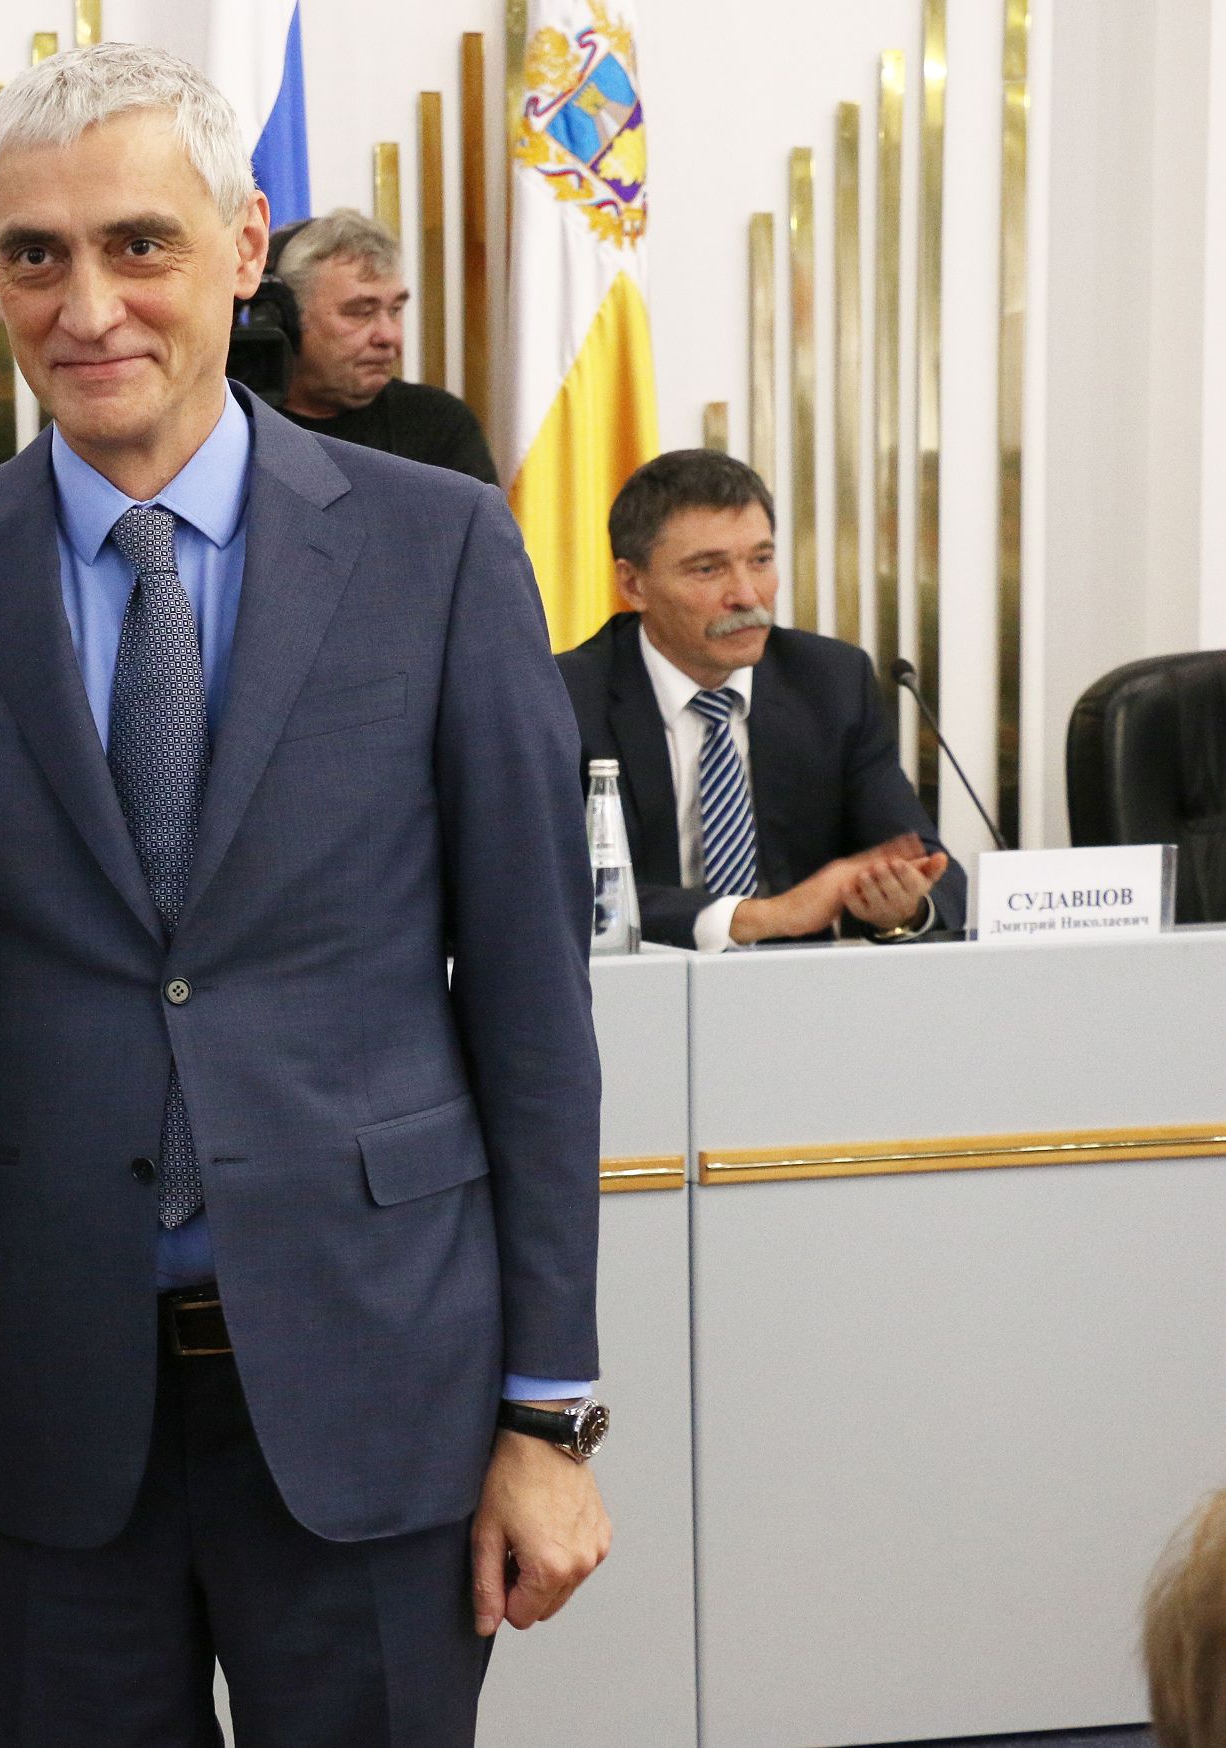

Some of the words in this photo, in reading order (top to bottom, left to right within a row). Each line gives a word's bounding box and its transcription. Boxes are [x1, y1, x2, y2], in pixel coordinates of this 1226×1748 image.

[1008, 888, 1134, 912] СУДАВЦОВ
[990, 918, 1056, 935] Дмитрий
[1061, 915, 1150, 931] Николаевич
